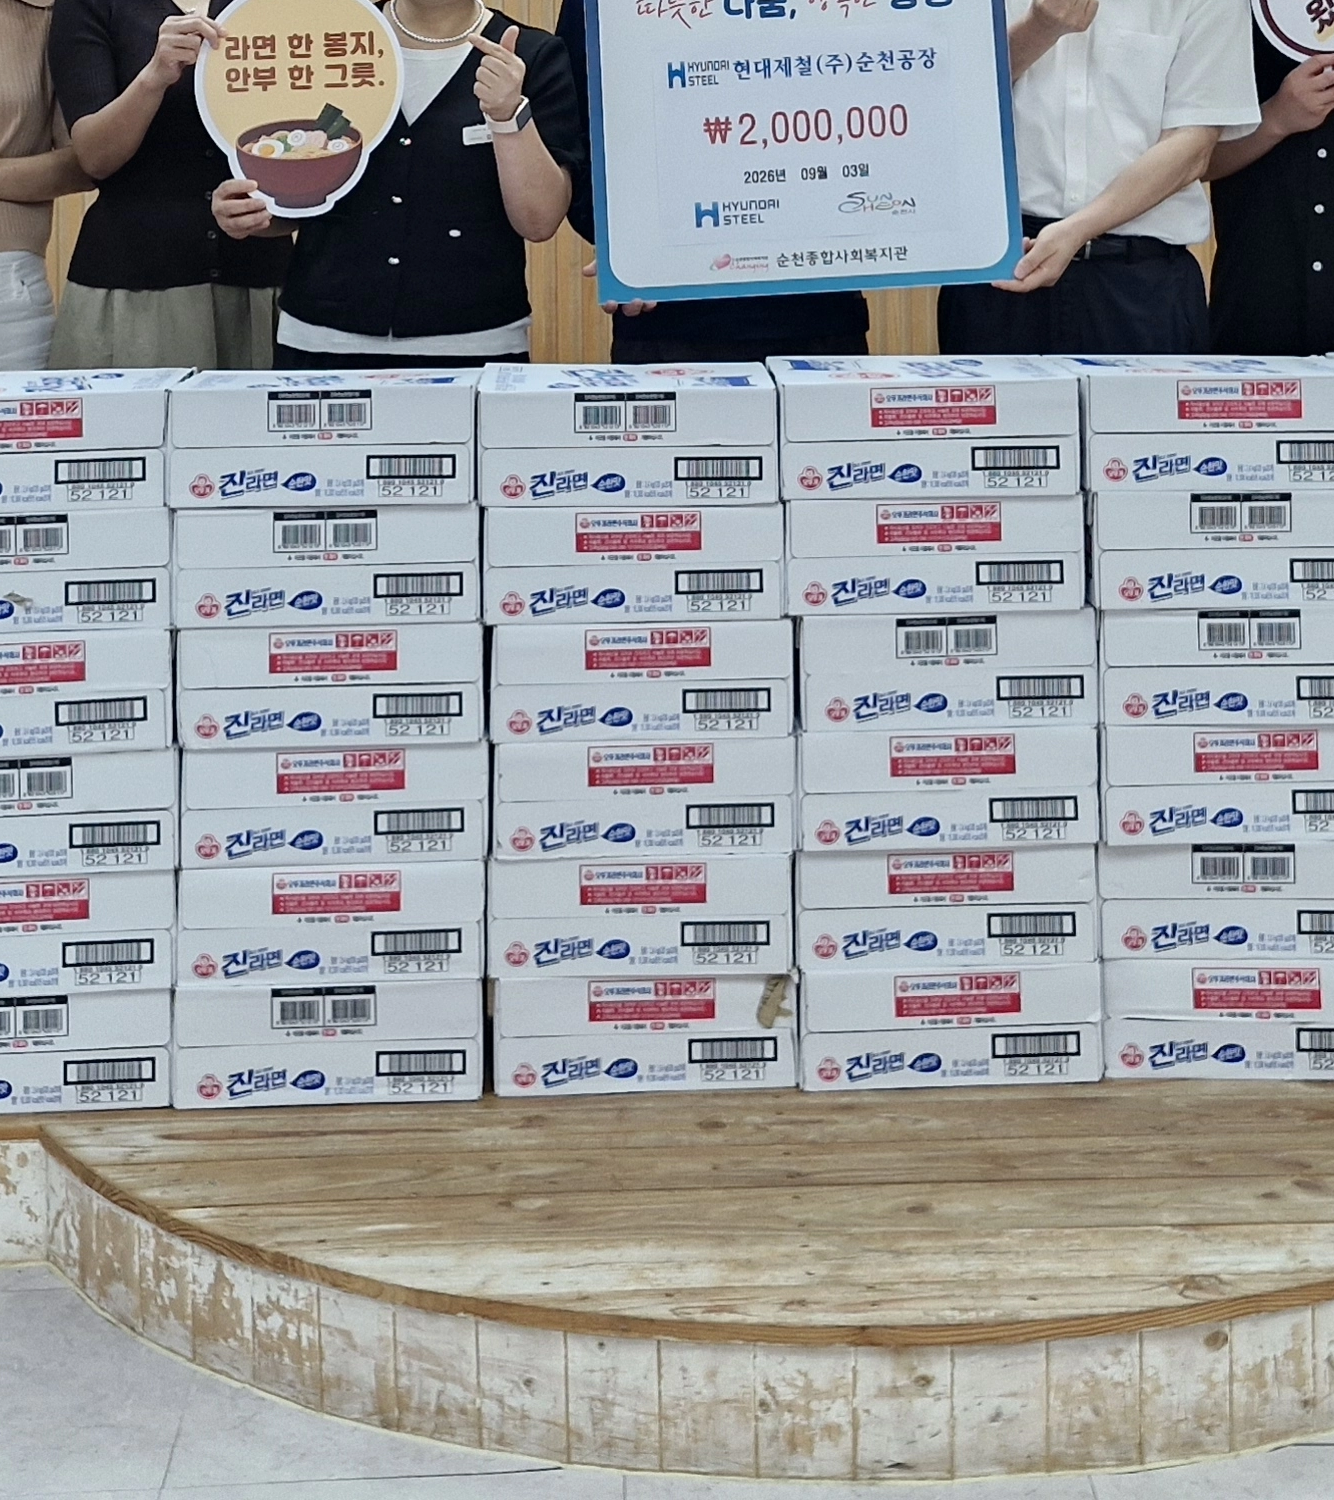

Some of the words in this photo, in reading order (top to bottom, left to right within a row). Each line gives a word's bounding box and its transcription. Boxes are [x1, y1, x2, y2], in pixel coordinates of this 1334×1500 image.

[224, 35, 276, 61] 라면
[287, 33, 313, 59] 한
[323, 30, 384, 58] 봉지,
[225, 66, 277, 93] 안부
[288, 64, 314, 91] 한
[323, 62, 385, 89] 그릇.
[687, 60, 730, 72] HYUNDAI
[733, 48, 937, 81] 현대제철(주)순천공장
[688, 75, 719, 87] STEEL
[703, 104, 908, 150] ₩2,000,000
[744, 168, 787, 184] 2026년
[801, 166, 828, 180] 09월
[842, 163, 870, 178] 03일
[722, 199, 780, 212] HYUNDAI
[723, 214, 765, 226] STEEL
[776, 246, 908, 269] 순천종합사회복지관
[827, 463, 885, 491] 진라면
[1132, 456, 1191, 483] 진라면
[220, 470, 278, 498] 진라면
[530, 471, 588, 499] 진라면
[832, 577, 890, 607] 진라면
[1148, 574, 1205, 601] 진라면
[226, 589, 285, 616] 진라면
[530, 588, 588, 616] 진라면
[854, 693, 911, 720] 진라면
[1152, 691, 1210, 718] 진라면
[224, 710, 284, 740] 진라면
[538, 707, 596, 734] 진라면
[845, 817, 903, 844] 진라면
[1149, 807, 1207, 834] 진라면
[226, 828, 286, 859] 진라면
[540, 822, 599, 851] 진라면
[842, 931, 900, 958] 진라면
[1151, 924, 1210, 949] 진라면
[224, 950, 283, 978] 진라면
[534, 939, 593, 966] 진라면
[847, 1055, 904, 1082] 진라면
[1149, 1044, 1208, 1070] 진라면
[229, 1072, 287, 1099] 진라면
[542, 1061, 601, 1088] 진라면
